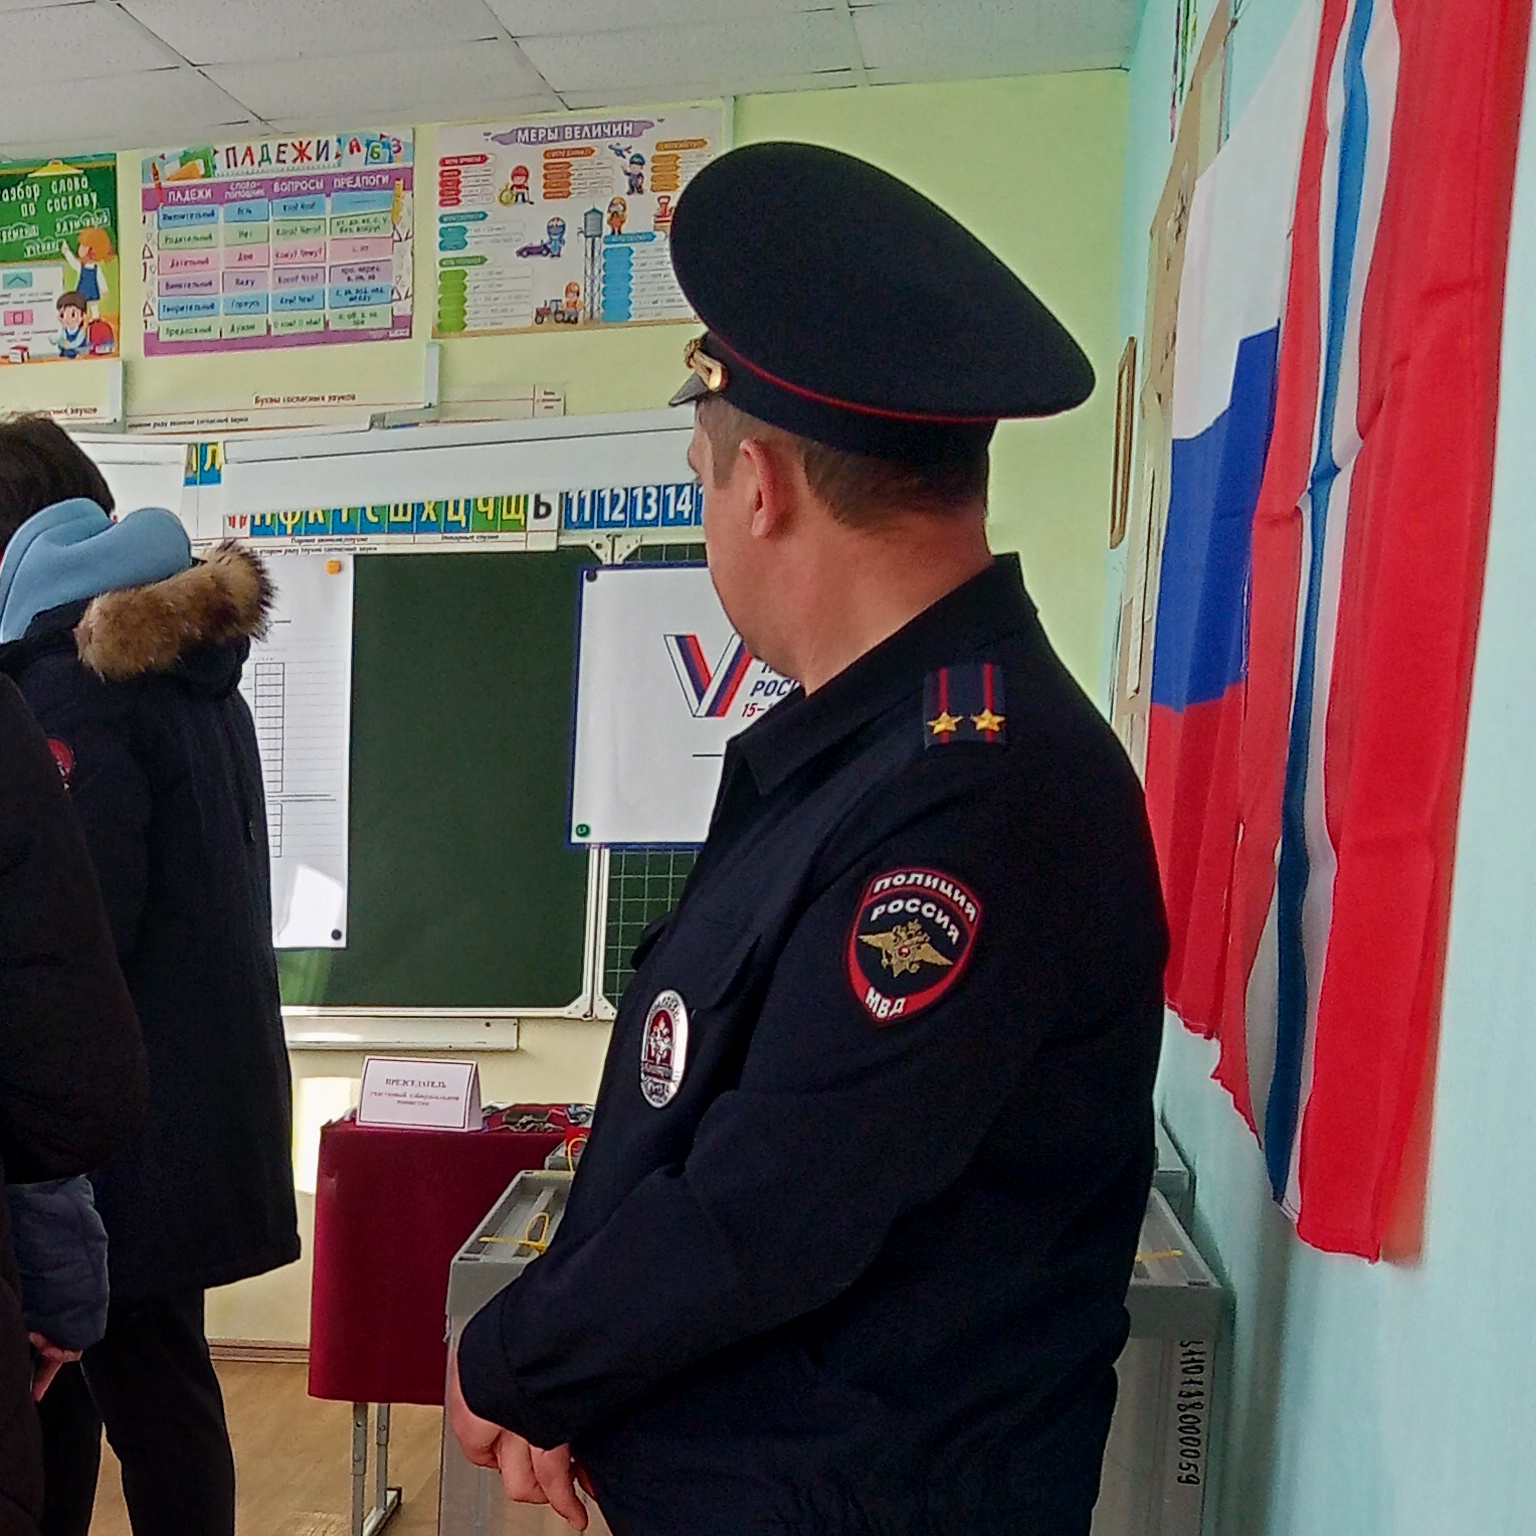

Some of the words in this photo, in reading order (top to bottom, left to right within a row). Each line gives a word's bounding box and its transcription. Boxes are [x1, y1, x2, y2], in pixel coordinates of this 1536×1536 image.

[517, 129, 559, 143] МЕРЫ
[565, 123, 633, 140] ВЕЛИЧИН
[225, 139, 330, 169] ПАДЕЖИ
[51, 176, 89, 194] слова
[273, 179, 324, 194] ВОПРОСЫ
[333, 174, 390, 188] ПРЕДЛОГИ
[21, 202, 36, 217] по
[46, 191, 98, 213] составу
[168, 188, 213, 203] ПАДЕЖИ
[501, 495, 526, 527] Щ
[533, 493, 553, 520] Ь
[568, 489, 592, 523] 11
[600, 488, 626, 522] 12
[632, 486, 659, 521] 13
[664, 485, 693, 520] 14
[742, 702, 770, 717] 15-
[873, 873, 978, 922] ПОЛИЦИЯ
[870, 898, 961, 945] РОССИЯ
[865, 986, 907, 1018] МВД
